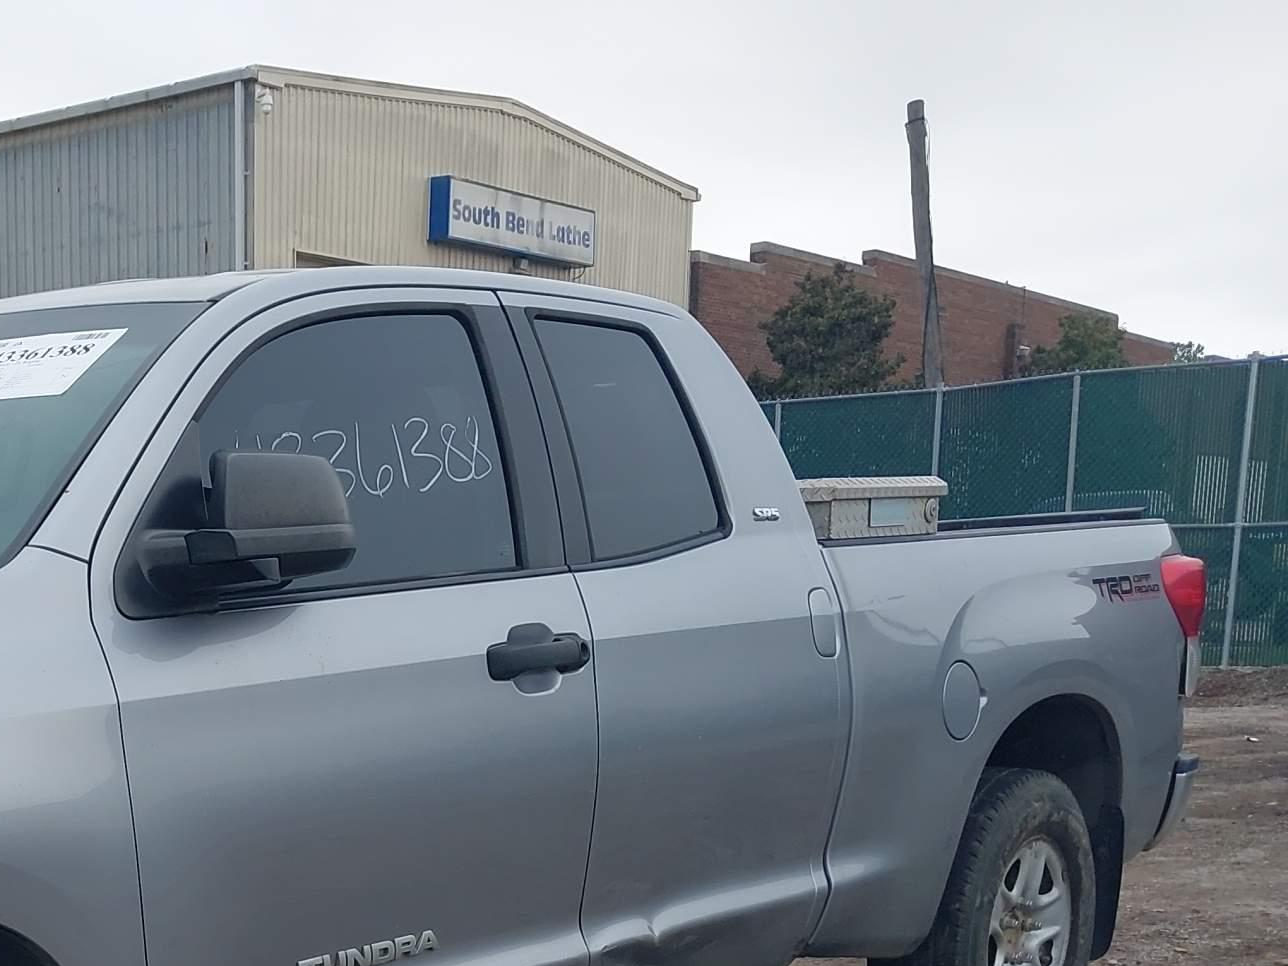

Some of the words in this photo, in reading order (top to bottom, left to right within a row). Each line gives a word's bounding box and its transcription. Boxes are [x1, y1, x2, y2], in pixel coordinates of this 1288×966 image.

[452, 199, 500, 230] South
[505, 211, 545, 238] Bend
[549, 221, 591, 249] Lathe
[234, 416, 493, 497] 361388
[1092, 576, 1133, 604] TRD
[1134, 584, 1160, 593] ROAD
